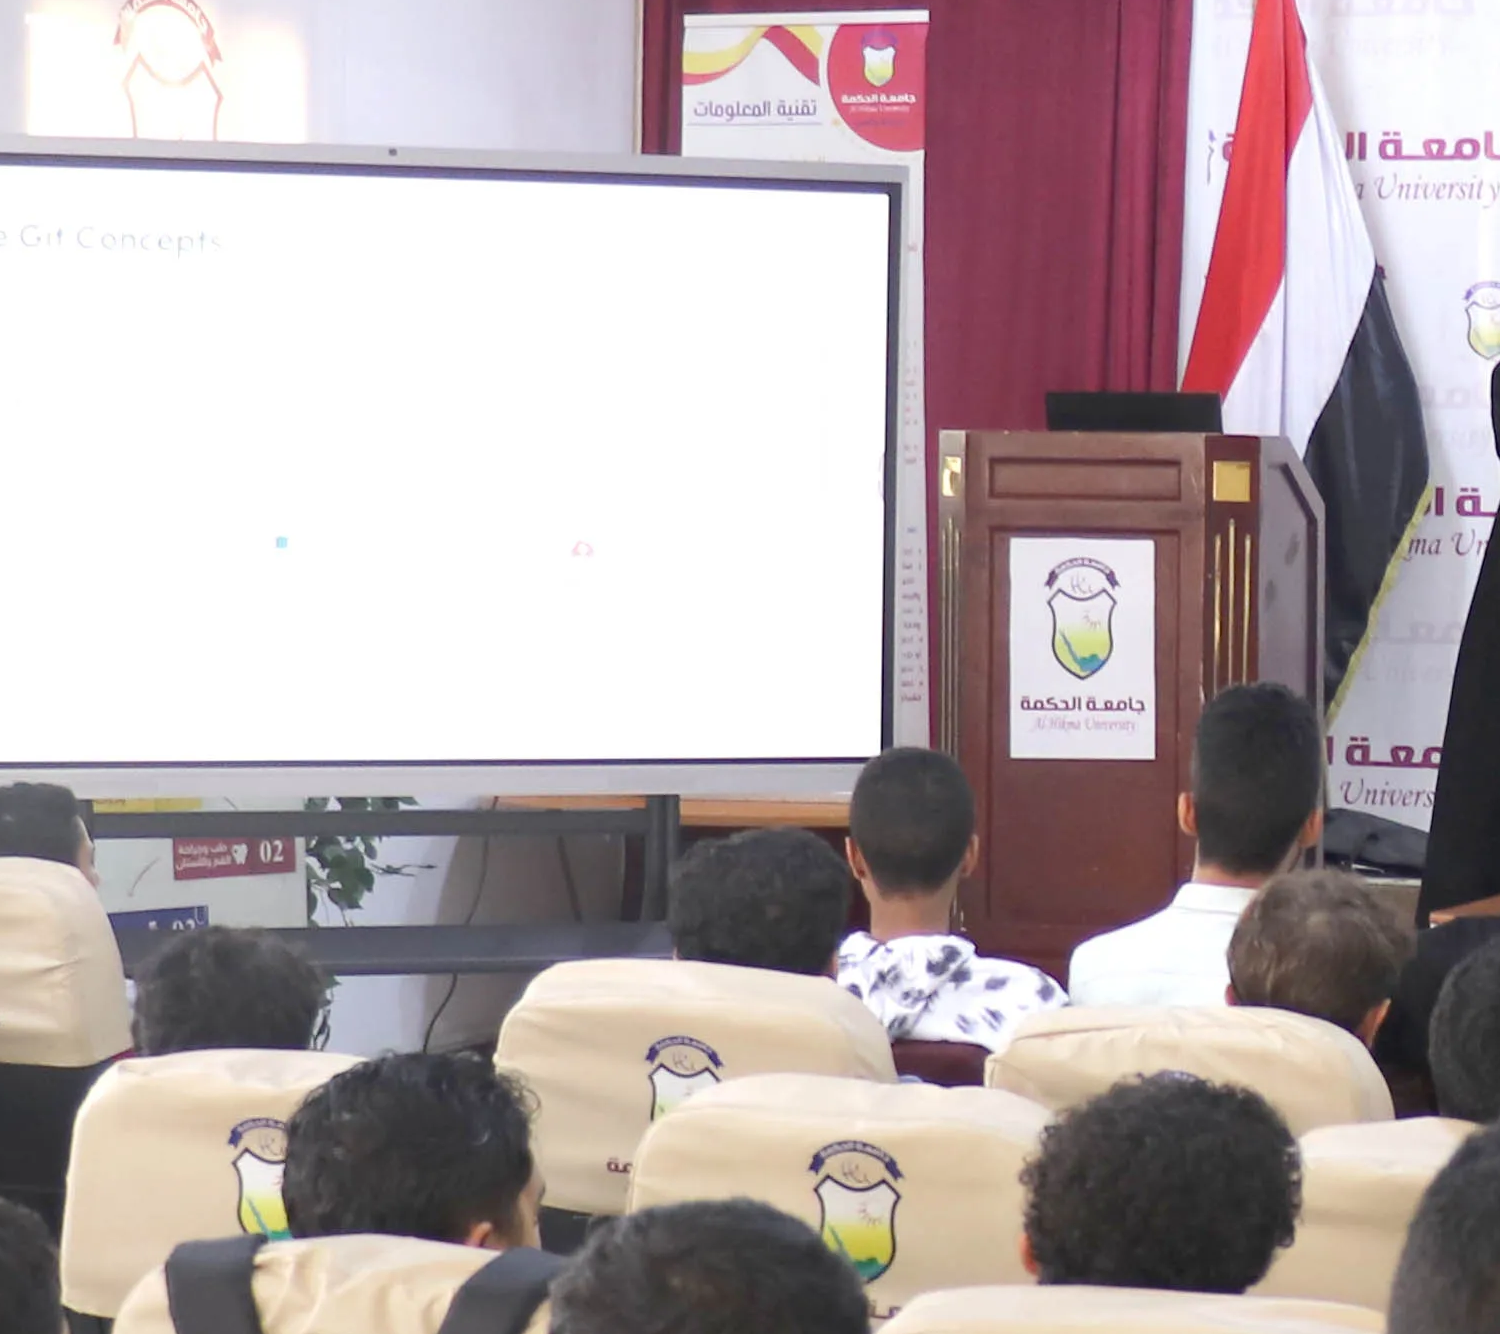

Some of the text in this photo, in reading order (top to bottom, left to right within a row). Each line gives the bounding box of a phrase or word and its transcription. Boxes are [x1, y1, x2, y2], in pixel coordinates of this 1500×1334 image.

[694, 99, 818, 122] تقنية المعلومات
[1375, 171, 1500, 209] University
[19, 223, 65, 248] Git
[77, 225, 223, 260] Concepts
[1020, 696, 1147, 716] جامعة الحكمة
[259, 839, 285, 864] 02
